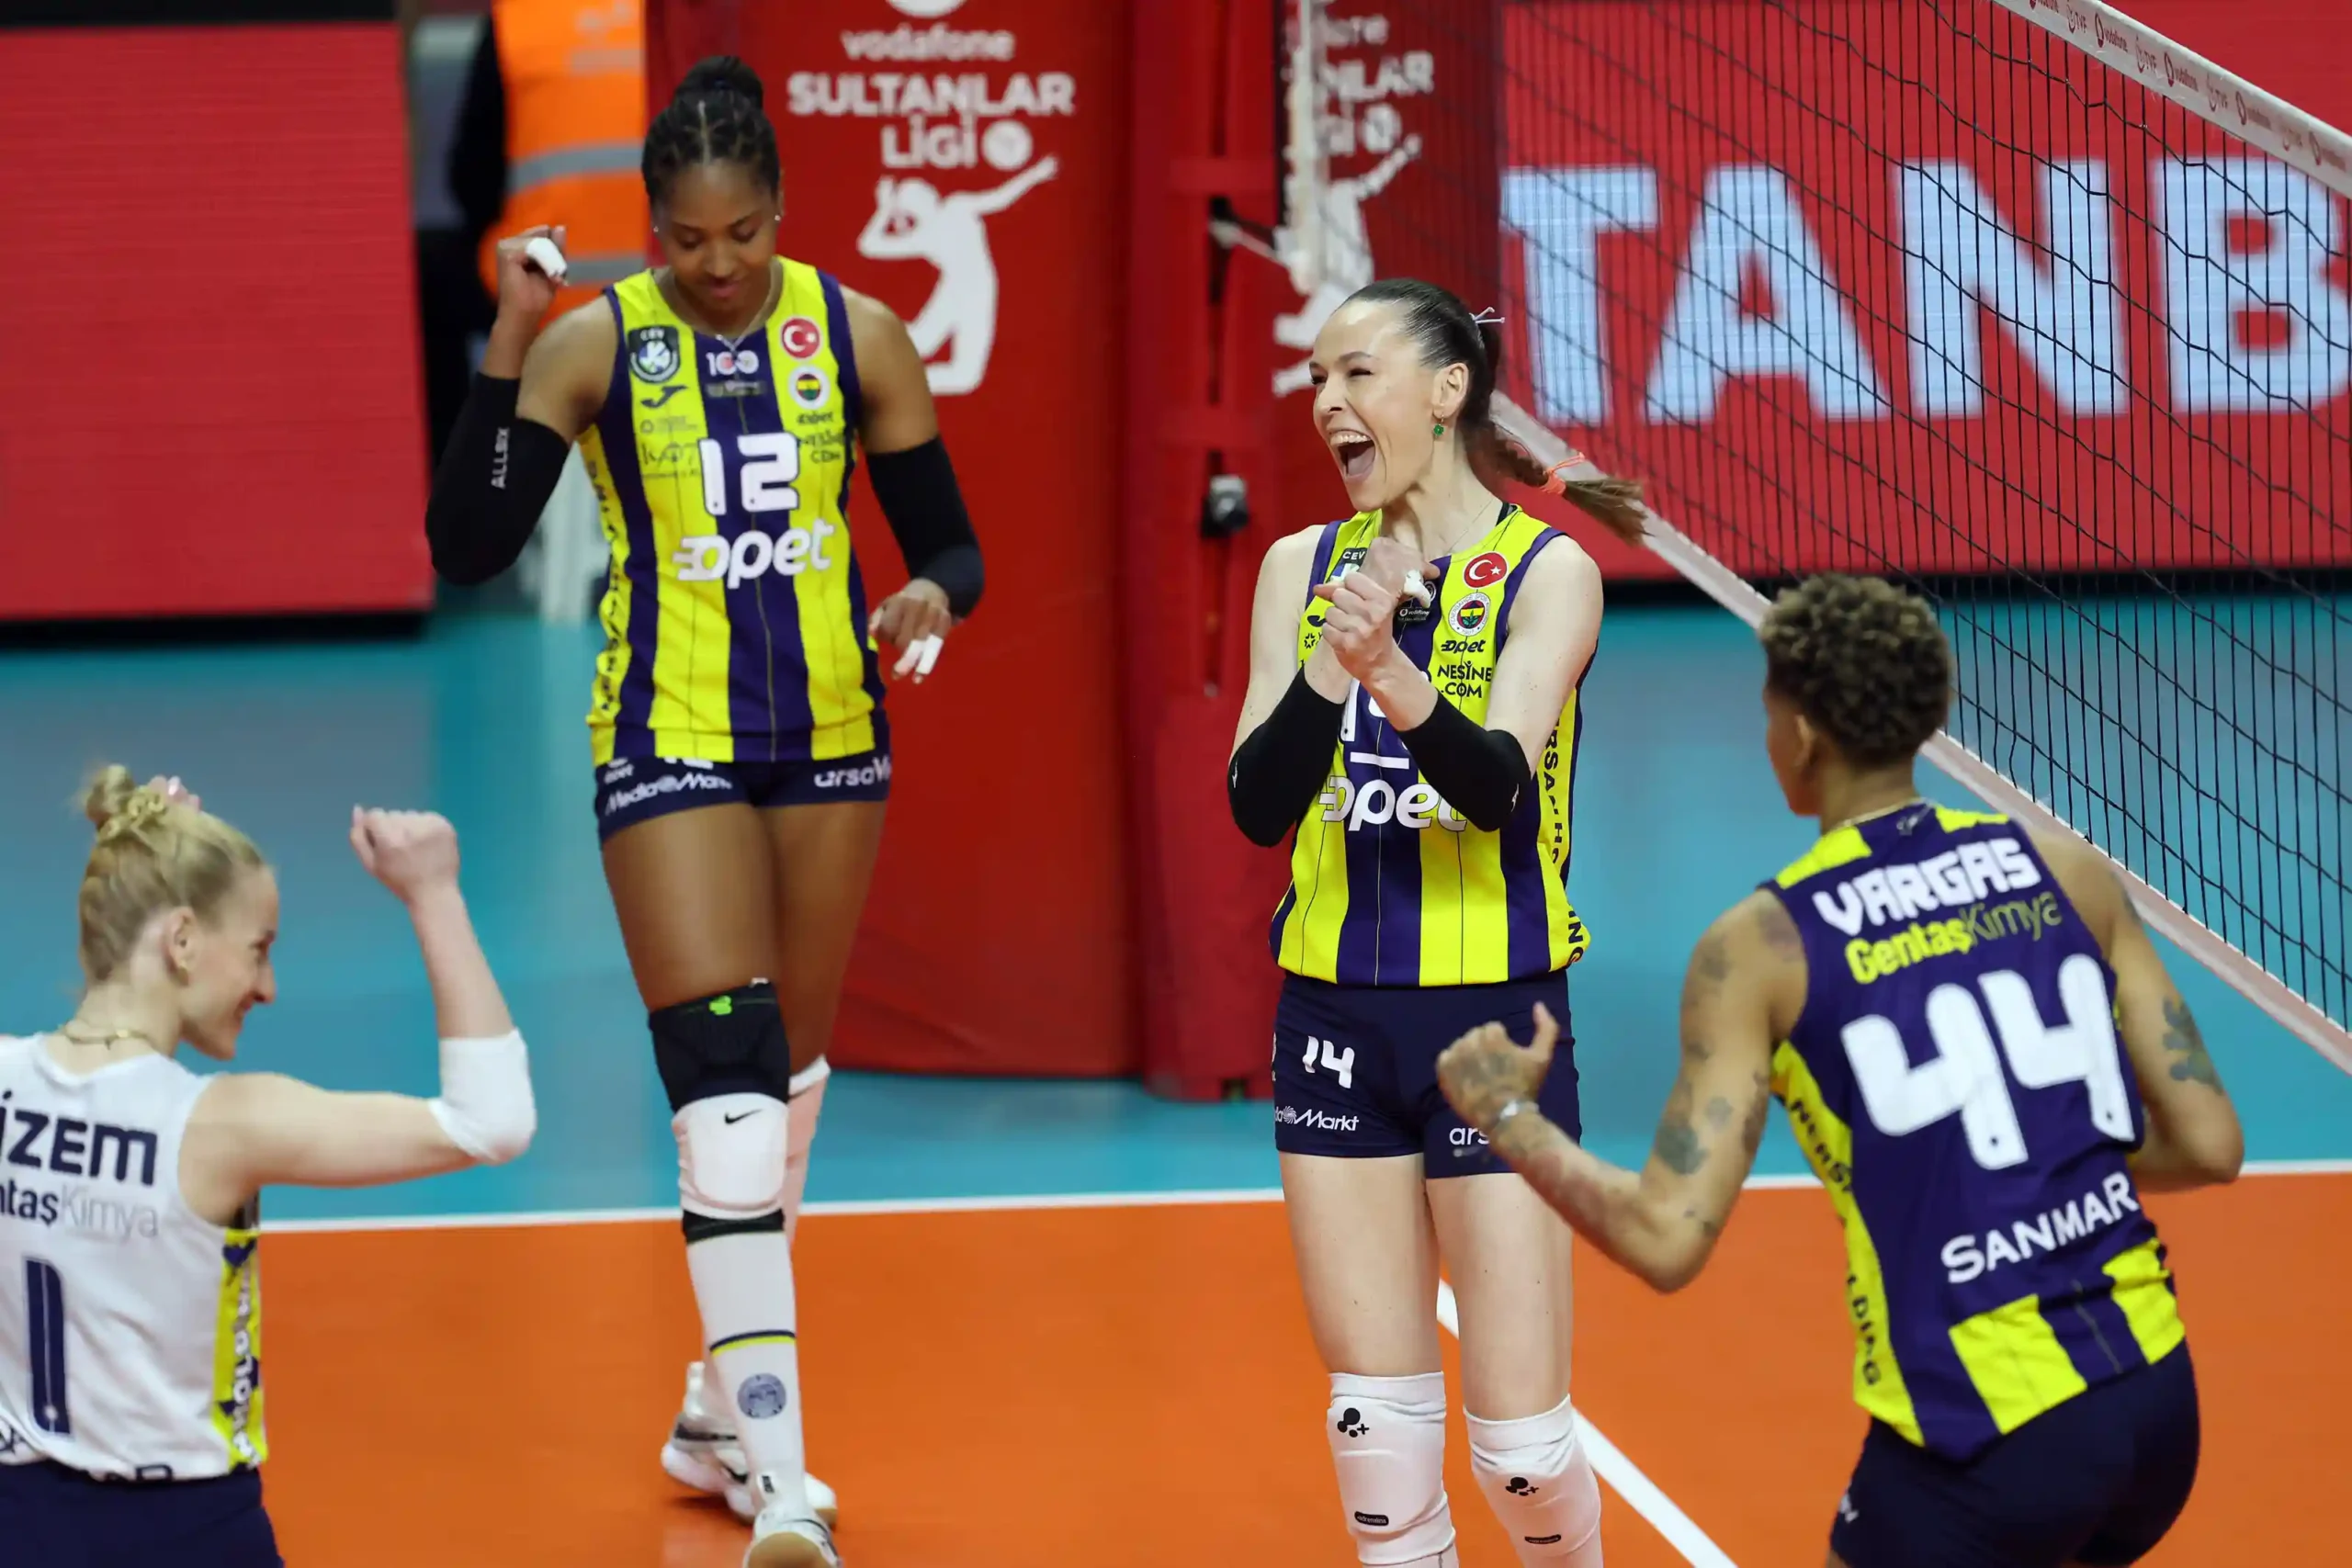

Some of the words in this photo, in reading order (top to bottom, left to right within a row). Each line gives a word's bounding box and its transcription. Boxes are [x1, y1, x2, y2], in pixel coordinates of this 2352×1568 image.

[840, 23, 1016, 62] vodafone
[786, 72, 1075, 116] SULTANLAR
[698, 432, 799, 516] 12
[1342, 550, 1365, 560] CEV
[1812, 838, 2041, 937] VARGAS
[1302, 1035, 1355, 1089] 14
[1840, 953, 2135, 1171] 44
[1295, 1109, 1360, 1132] Markt
[1940, 1171, 2140, 1284] SANMAR
[26, 1258, 72, 1436] 1
